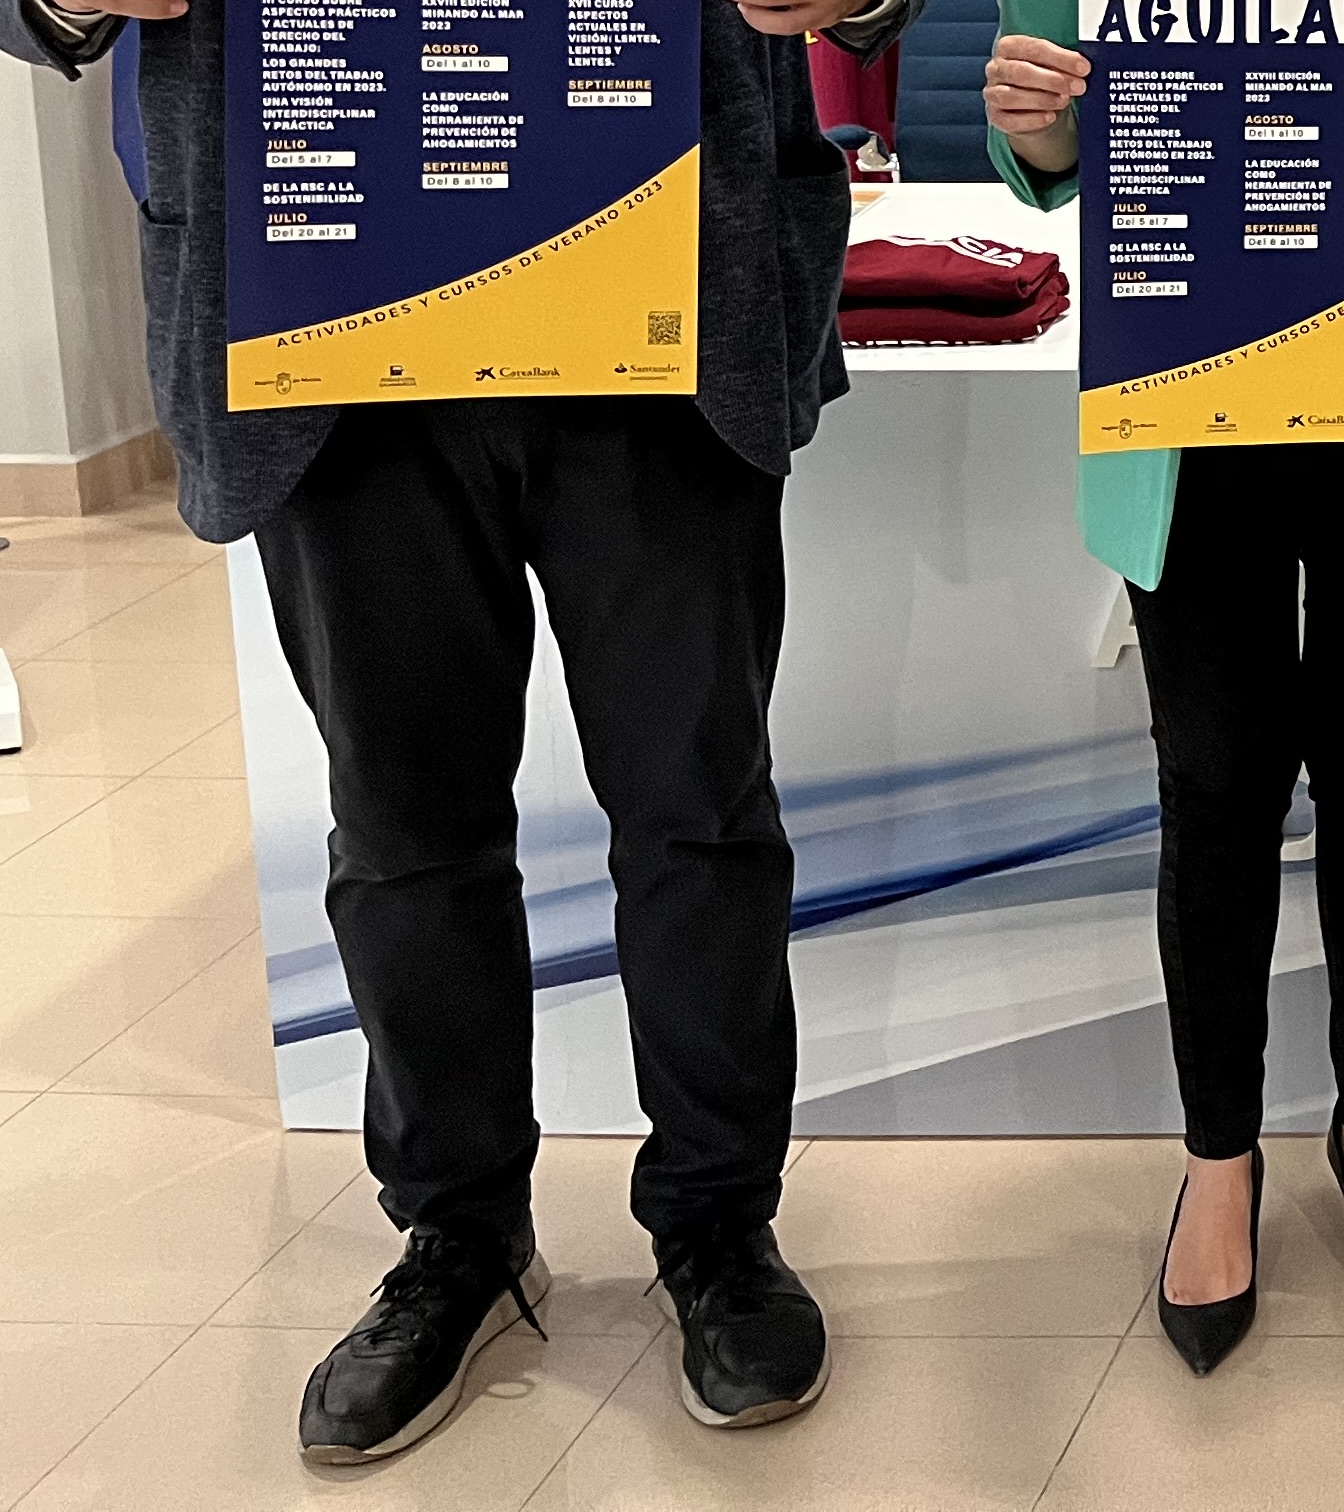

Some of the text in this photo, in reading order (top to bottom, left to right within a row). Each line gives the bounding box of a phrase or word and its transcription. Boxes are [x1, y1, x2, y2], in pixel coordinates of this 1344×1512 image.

[262, 6, 396, 17] ASPECTOS PRÁCTICOS
[262, 19, 353, 28] Y ACTUALES DE
[262, 31, 345, 40] DERECHO DEL
[1278, 71, 1320, 80] EDICIÓN
[1245, 83, 1293, 91] MIRANDO
[1310, 83, 1332, 91] MAR
[1245, 94, 1270, 102] 2023
[1245, 115, 1293, 124] AGOSTO
[276, 303, 412, 347] ACTIVIDADES
[417, 296, 429, 307] Y
[437, 264, 511, 301] CURSOS
[518, 250, 543, 268] DE
[623, 179, 663, 209] 2023
[1119, 355, 1234, 395] ACTIVIDADES
[1239, 348, 1249, 359] Y
[1256, 319, 1320, 353] CURSOS
